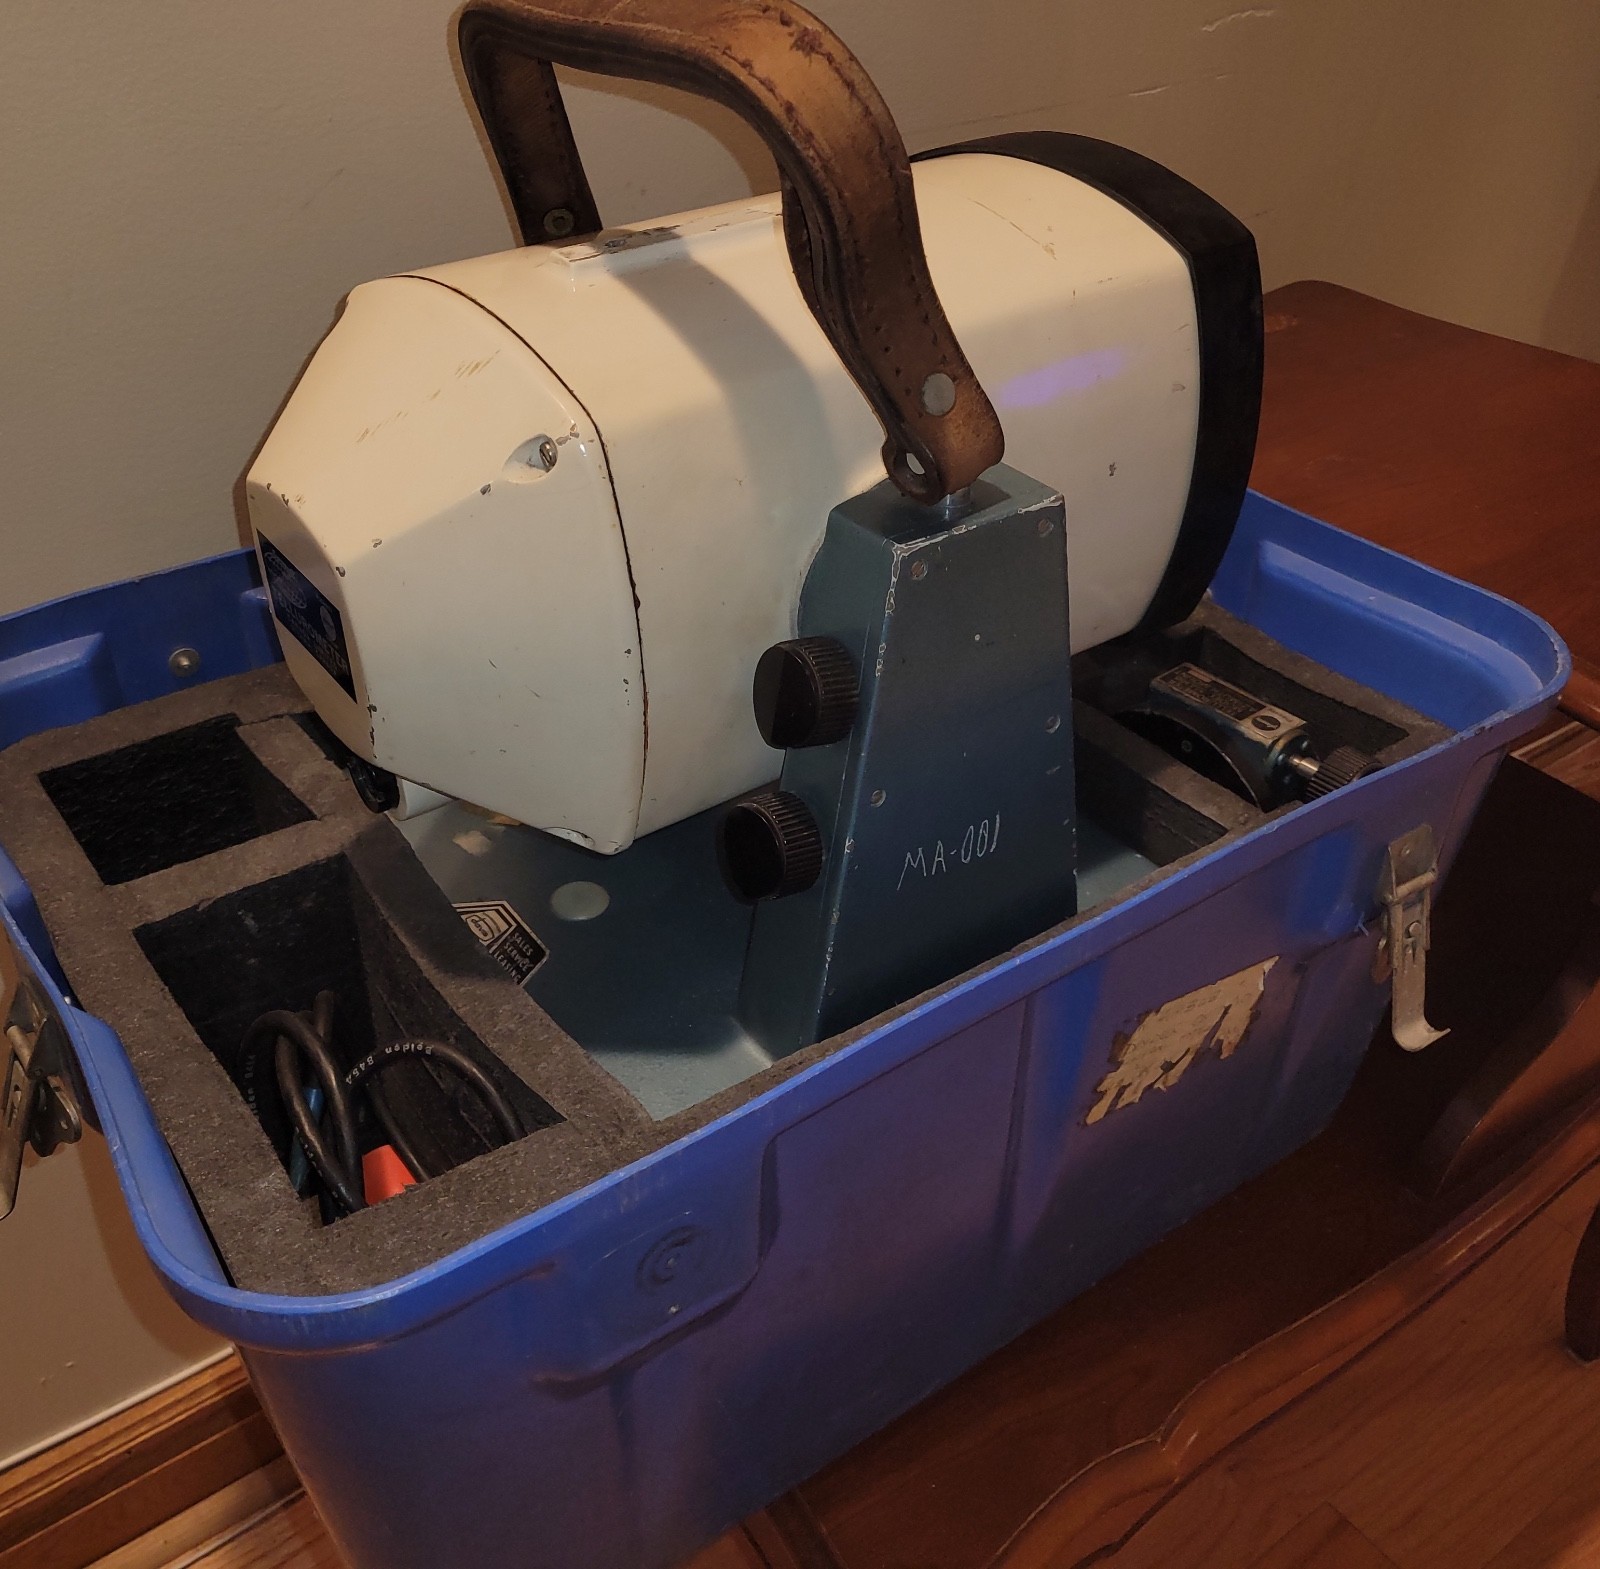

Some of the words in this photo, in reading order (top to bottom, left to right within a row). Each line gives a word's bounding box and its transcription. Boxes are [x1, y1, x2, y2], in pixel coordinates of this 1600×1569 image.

[897, 810, 1000, 891] MA-001
[503, 943, 529, 972] SERVICE
[513, 933, 533, 956] SALES
[494, 951, 522, 983] LEASING
